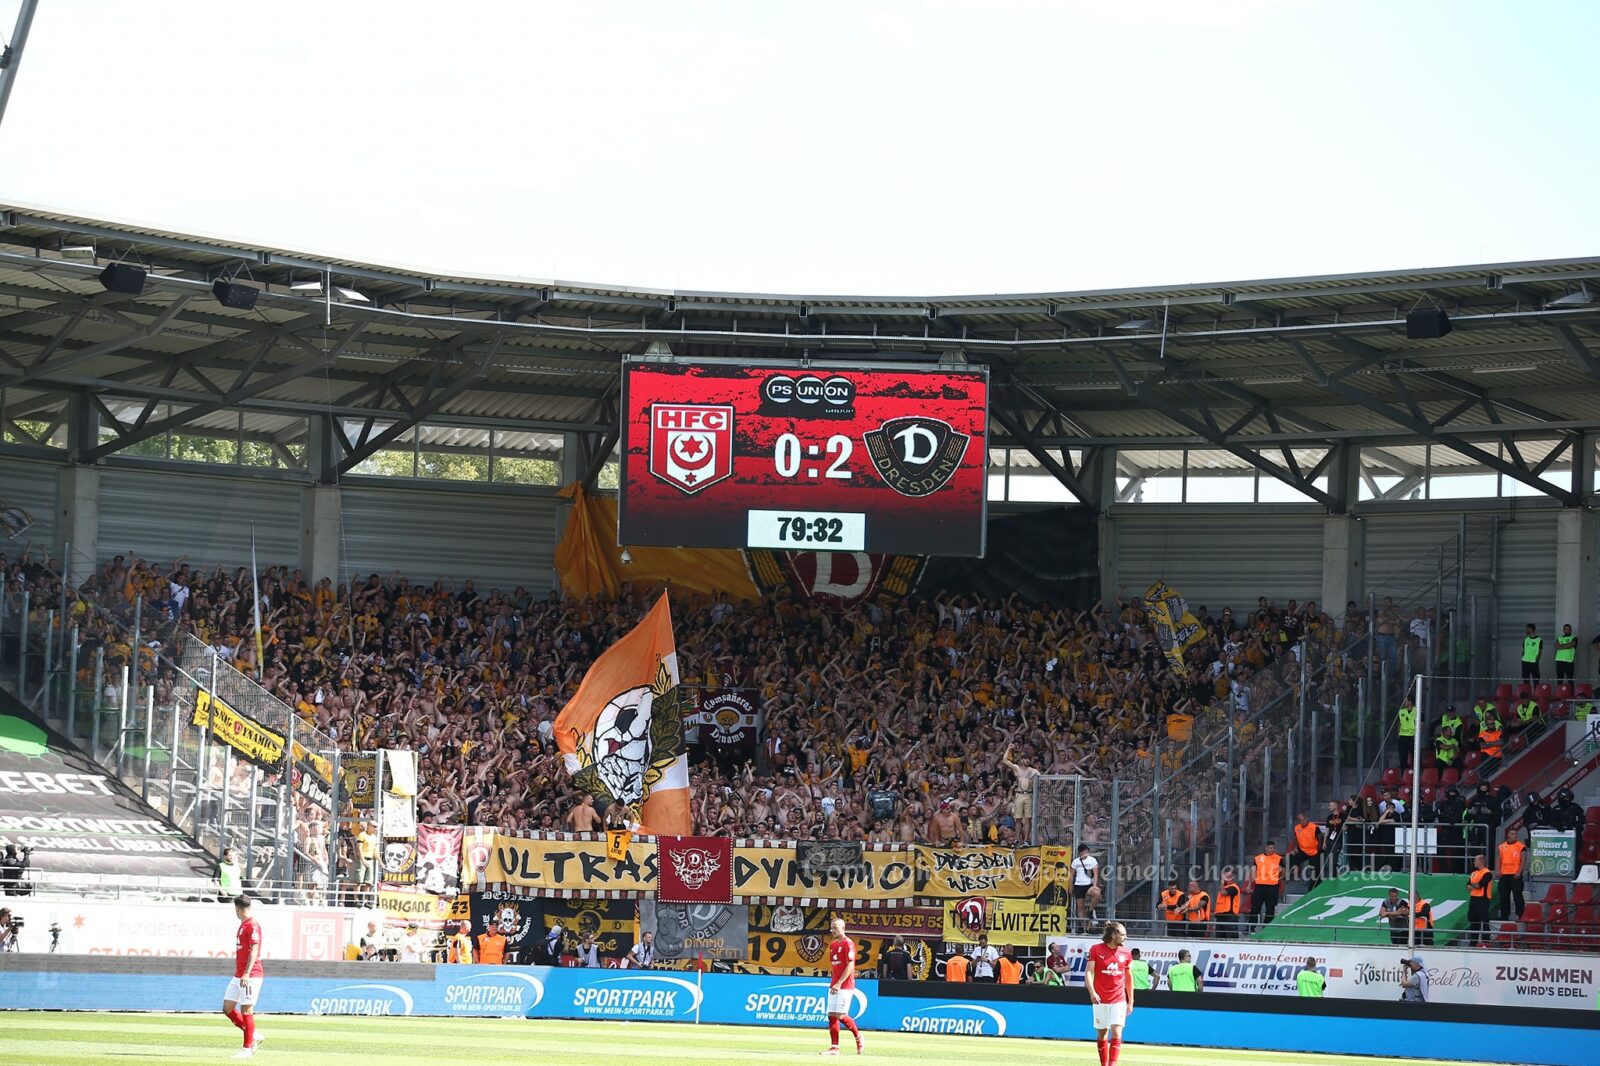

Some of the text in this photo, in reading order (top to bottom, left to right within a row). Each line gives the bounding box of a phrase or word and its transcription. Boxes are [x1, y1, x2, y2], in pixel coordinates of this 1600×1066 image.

[772, 385, 849, 396] PS UNION
[660, 410, 724, 429] HFC
[774, 432, 853, 479] 0:2
[878, 457, 954, 493] DRESDEN
[777, 517, 843, 542] 79:32
[703, 692, 753, 712] Compañeros
[0, 771, 115, 796] EBET
[614, 835, 621, 849] 6
[1536, 840, 1562, 849] Wasser
[933, 851, 1014, 872] DRESDEN
[1532, 848, 1573, 858] Entsorgung
[498, 846, 912, 891] ULTRAS DYNAMO
[945, 874, 1005, 893] WEST
[381, 898, 432, 913] BRIGADE
[305, 923, 331, 934] HFC
[830, 910, 925, 930] AKTIVIST
[1354, 962, 1404, 986] Köstrit
[1427, 967, 1482, 988] Edel Pils
[1495, 965, 1593, 985] ZUSAMMEN
[444, 984, 524, 1004] SPORTPARK
[1259, 981, 1280, 990] der
[1516, 985, 1588, 998] WIRD'S EDEL.
[309, 998, 394, 1016] SPORTPARK
[573, 986, 677, 1008] SPORTPARK
[744, 992, 830, 1015] SPORTPA
[452, 1003, 522, 1012] WWW.MEIN-SPORTPARK.DE
[583, 1005, 675, 1017] WWW.MEIN-SPORTPARK.DE
[755, 1011, 829, 1022] WWW.MEIN-SPORTPA
[900, 1015, 985, 1035] SPORTPARK
